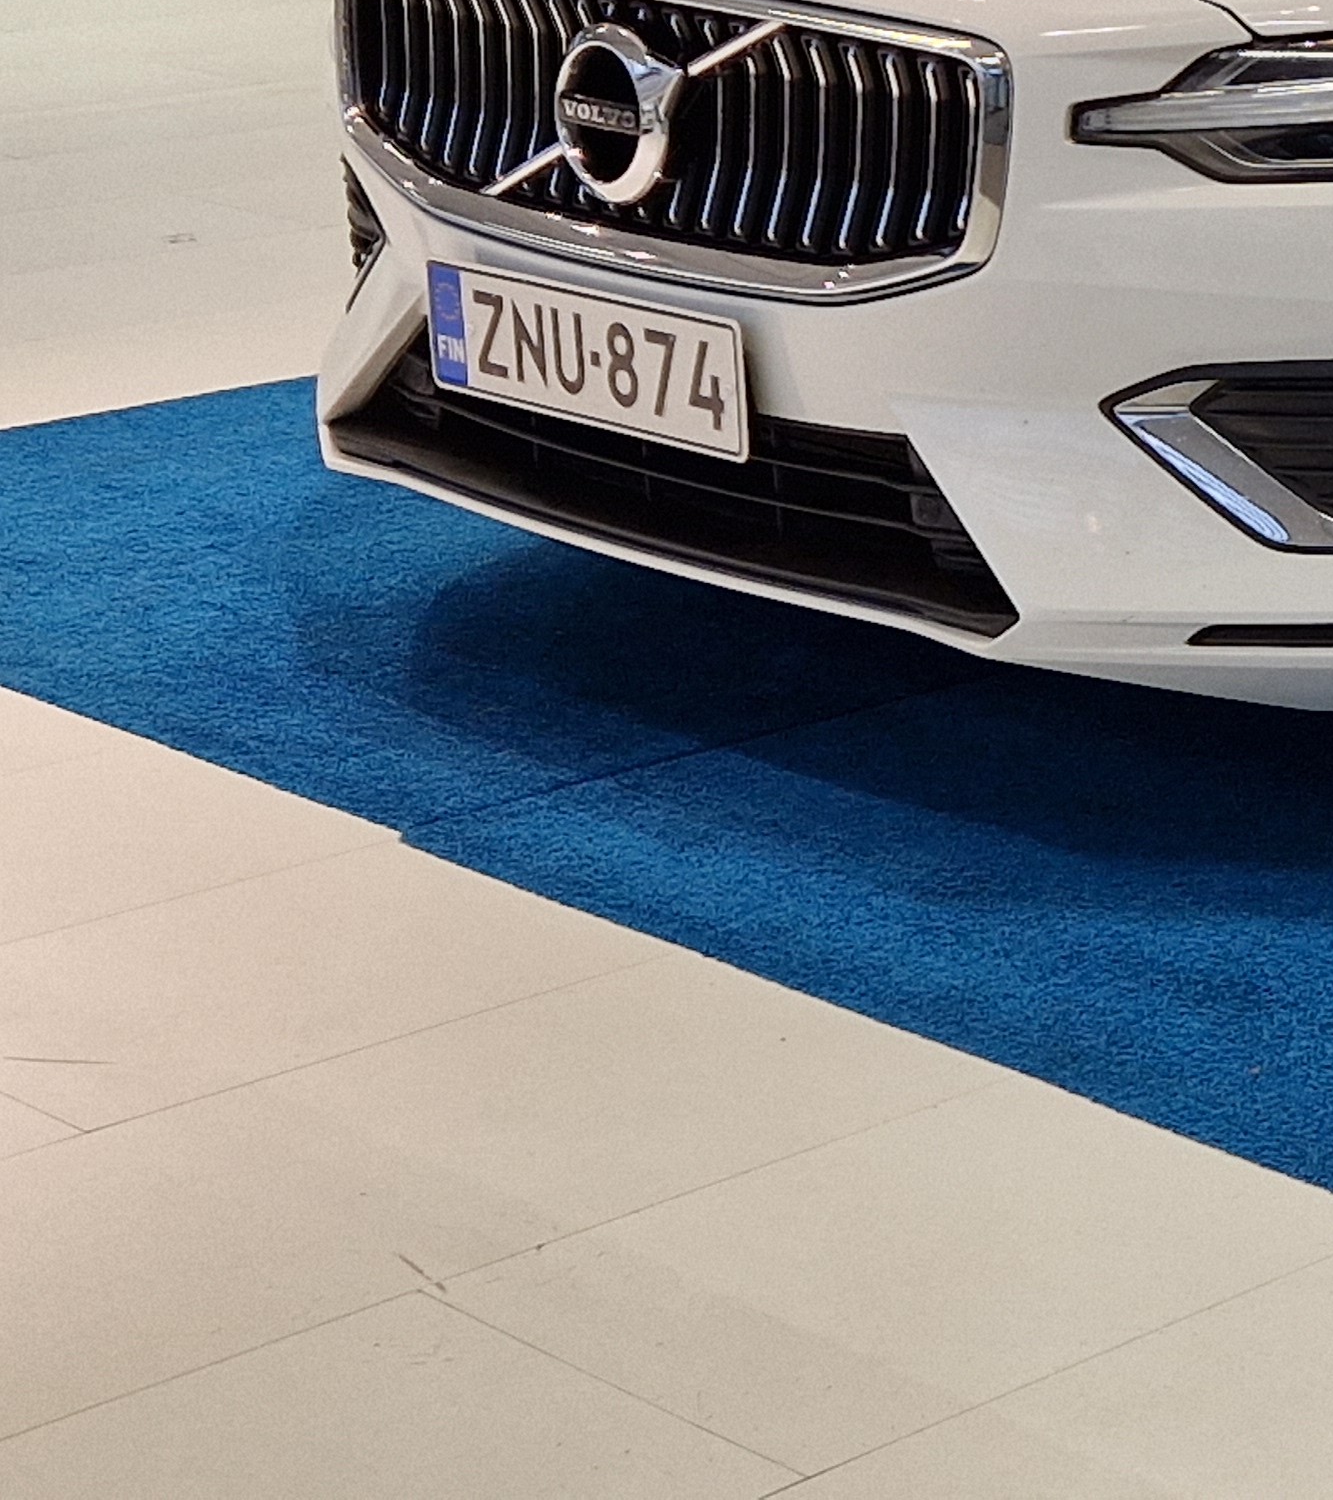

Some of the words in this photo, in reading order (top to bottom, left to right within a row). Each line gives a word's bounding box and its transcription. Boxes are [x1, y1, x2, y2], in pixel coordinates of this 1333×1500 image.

[561, 99, 636, 128] VOLVO
[437, 333, 464, 364] FIN
[473, 289, 724, 431] ZNU-874
